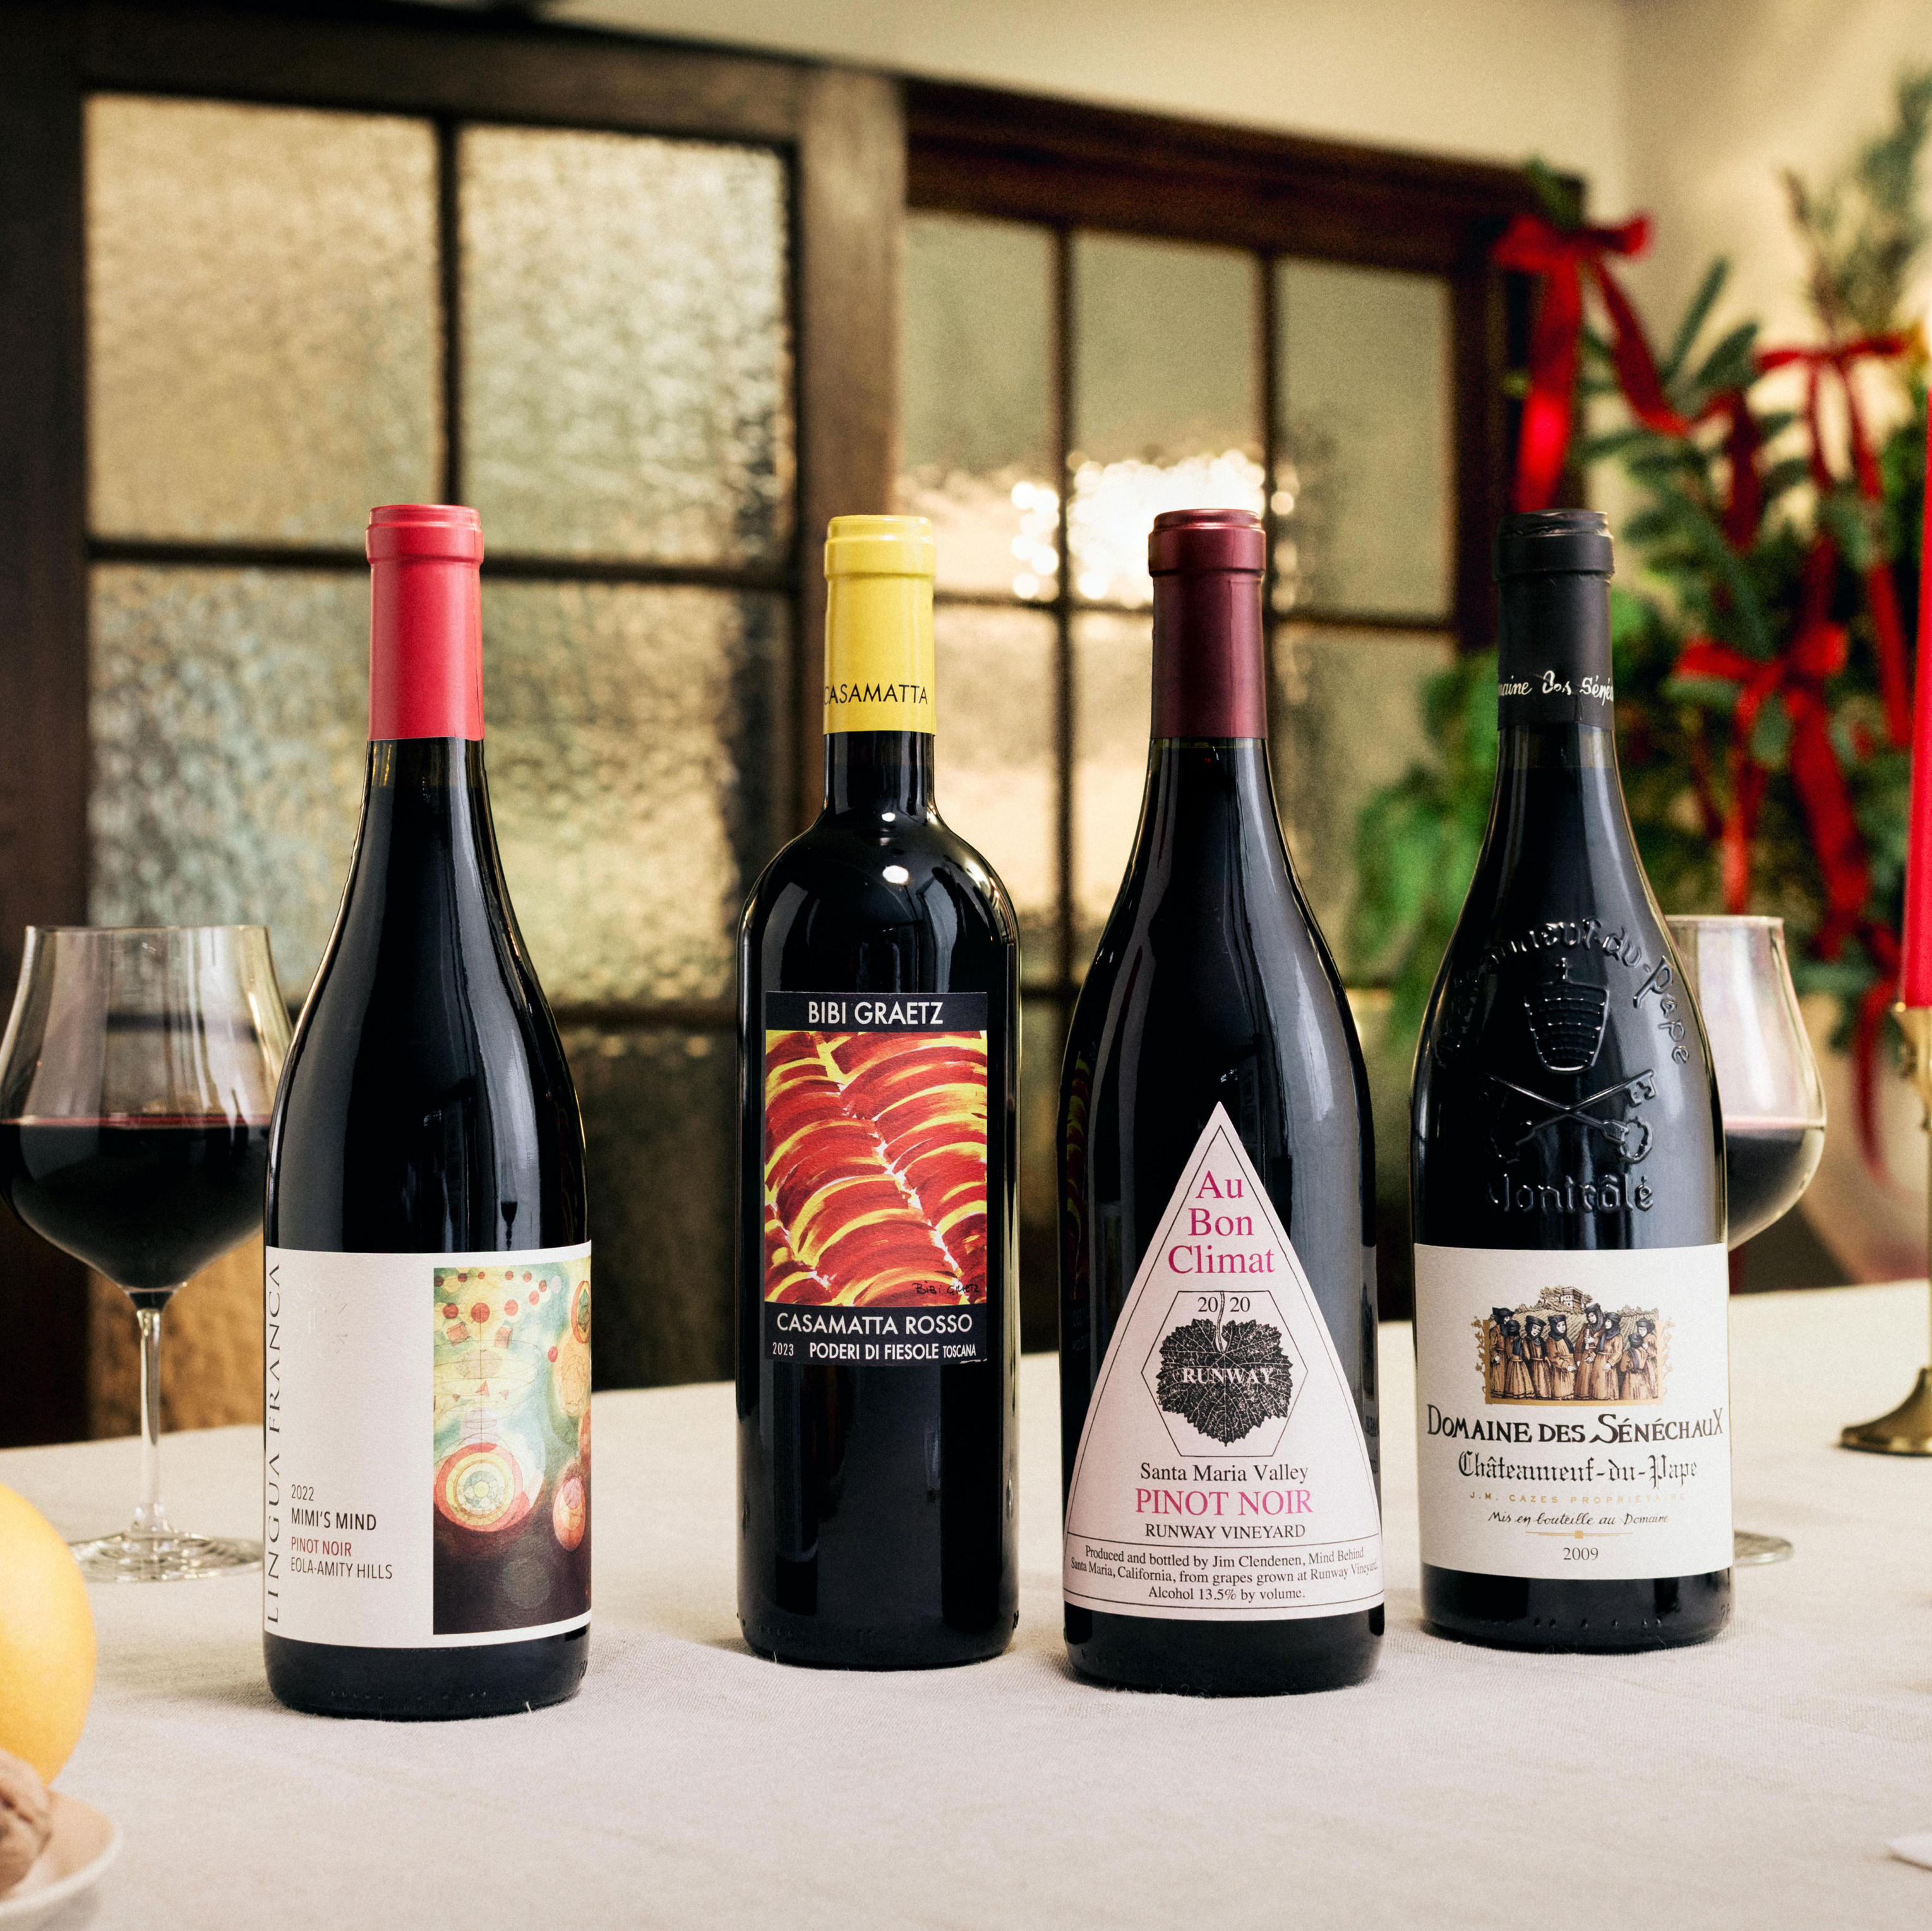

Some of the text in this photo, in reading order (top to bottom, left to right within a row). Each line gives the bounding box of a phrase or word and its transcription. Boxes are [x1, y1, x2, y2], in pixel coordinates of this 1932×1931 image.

[824, 683, 928, 705] CASAMATTA
[808, 1001, 944, 1025] BIBI GRAETZ
[1195, 1170, 1245, 1199] Au
[1187, 1207, 1254, 1236] Bon
[1168, 1245, 1275, 1274] Climat
[1197, 1296, 1251, 1313] 20 20
[776, 1312, 973, 1335] CASAMATTA ROSSO
[772, 1341, 976, 1360] 2023 PODERI DI FIESOLE TOSCANA
[1182, 1367, 1275, 1384] RUNWAY
[267, 1264, 281, 1625] LINGUA FRANCA
[1537, 1423, 1586, 1444] DES
[1140, 1462, 1309, 1484] Santa Maria Valley
[1458, 1450, 1698, 1490] Châteauneuf-du-Pape
[291, 1484, 315, 1501] 2022
[1135, 1487, 1314, 1517] PINOT NOIR
[1509, 1494, 1559, 1505] CAZES
[335, 1512, 377, 1531] MIND
[1487, 1511, 1670, 1526] Mis en bouteille au Domaine
[1145, 1523, 1306, 1539] RUNWAY VINEYARD
[291, 1536, 352, 1557] PINOT NOIR
[1563, 1547, 1599, 1561] 2009
[291, 1557, 393, 1579] EOLA-AMITY HILLS
[1085, 1545, 1364, 1572] Produced and bottled by Jim Clendenen, Mind Behind
[1071, 1557, 1087, 1572] Santa
[1088, 1561, 1116, 1578] Maria,
[1117, 1566, 1176, 1583] California,
[1179, 1570, 1209, 1583] from
[1213, 1574, 1252, 1586] grapes
[1256, 1573, 1293, 1585] grown
[1297, 1570, 1307, 1581] at
[1311, 1569, 1348, 1580] Runway
[1148, 1586, 1306, 1604] Alcohol 13.5% by volume.
